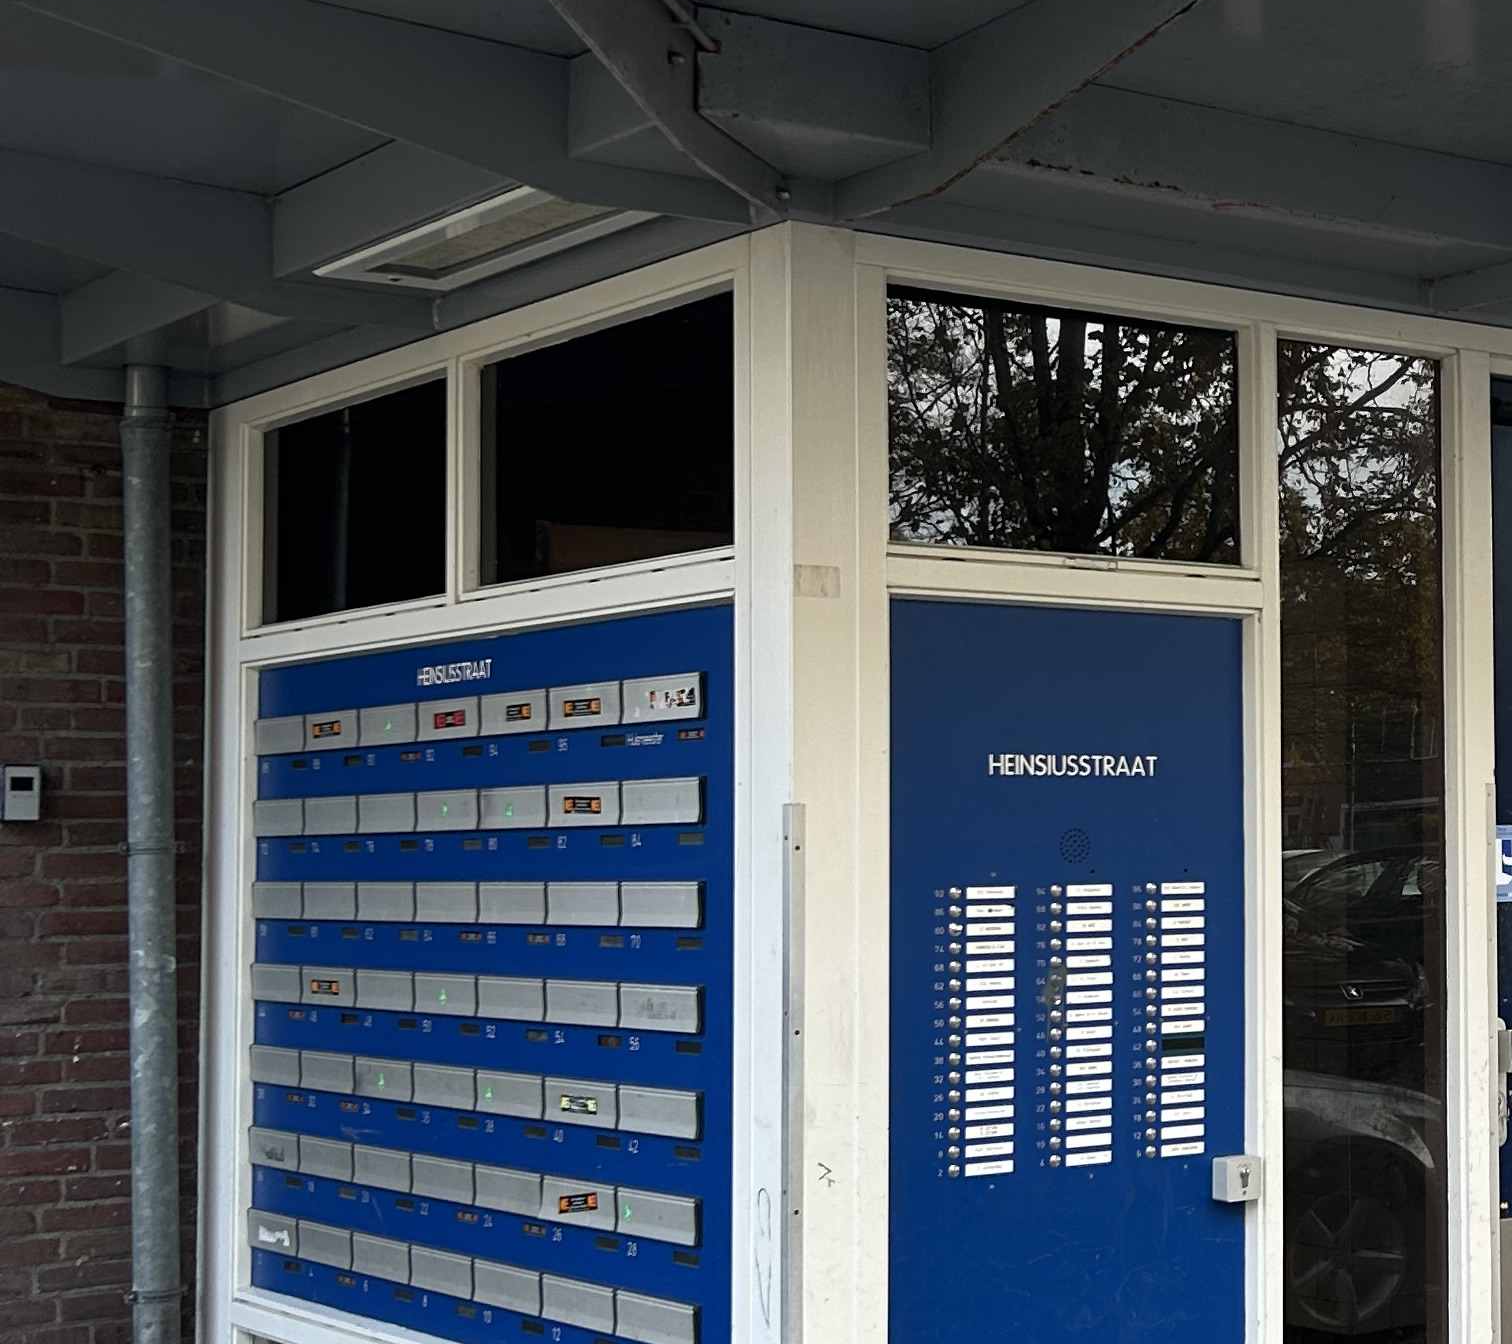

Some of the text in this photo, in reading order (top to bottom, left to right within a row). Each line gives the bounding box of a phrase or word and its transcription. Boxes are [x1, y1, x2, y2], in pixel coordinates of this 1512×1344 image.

[988, 753, 1158, 777] HEINSIUSSTRAAT
[936, 1168, 944, 1177] 2
[551, 1327, 561, 1342] 12
